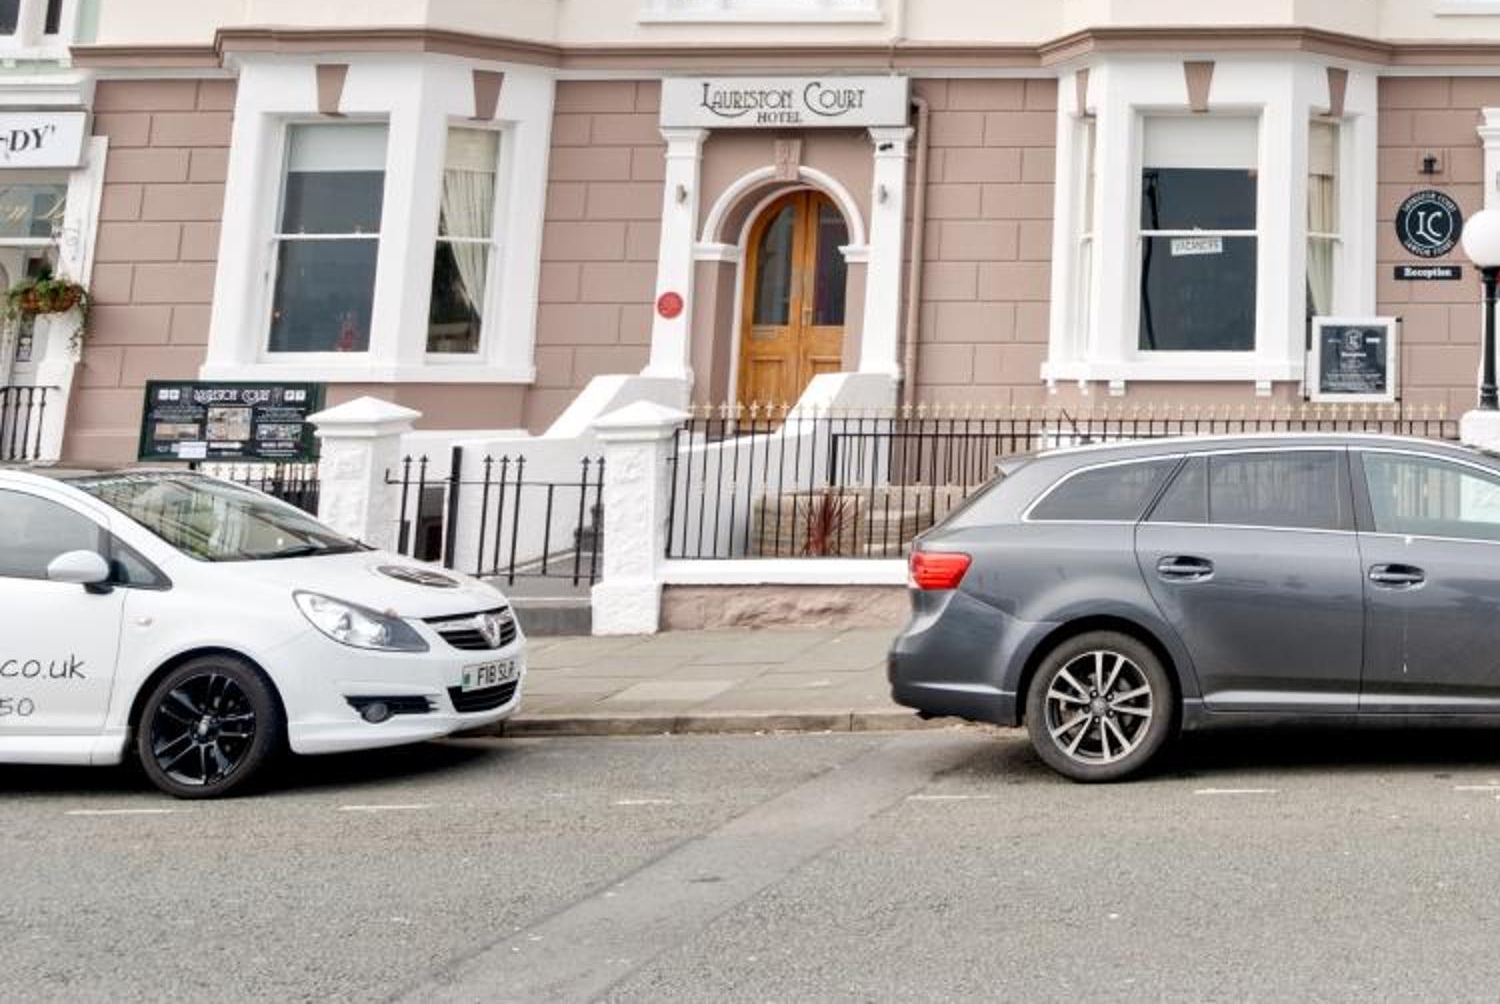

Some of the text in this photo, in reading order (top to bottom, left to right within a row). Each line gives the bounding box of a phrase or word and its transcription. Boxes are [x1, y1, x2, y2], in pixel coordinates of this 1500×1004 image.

[803, 81, 865, 116] COURT
[756, 111, 802, 124] HOTEL
[1415, 210, 1443, 246] LC
[1403, 267, 1453, 279] Reception
